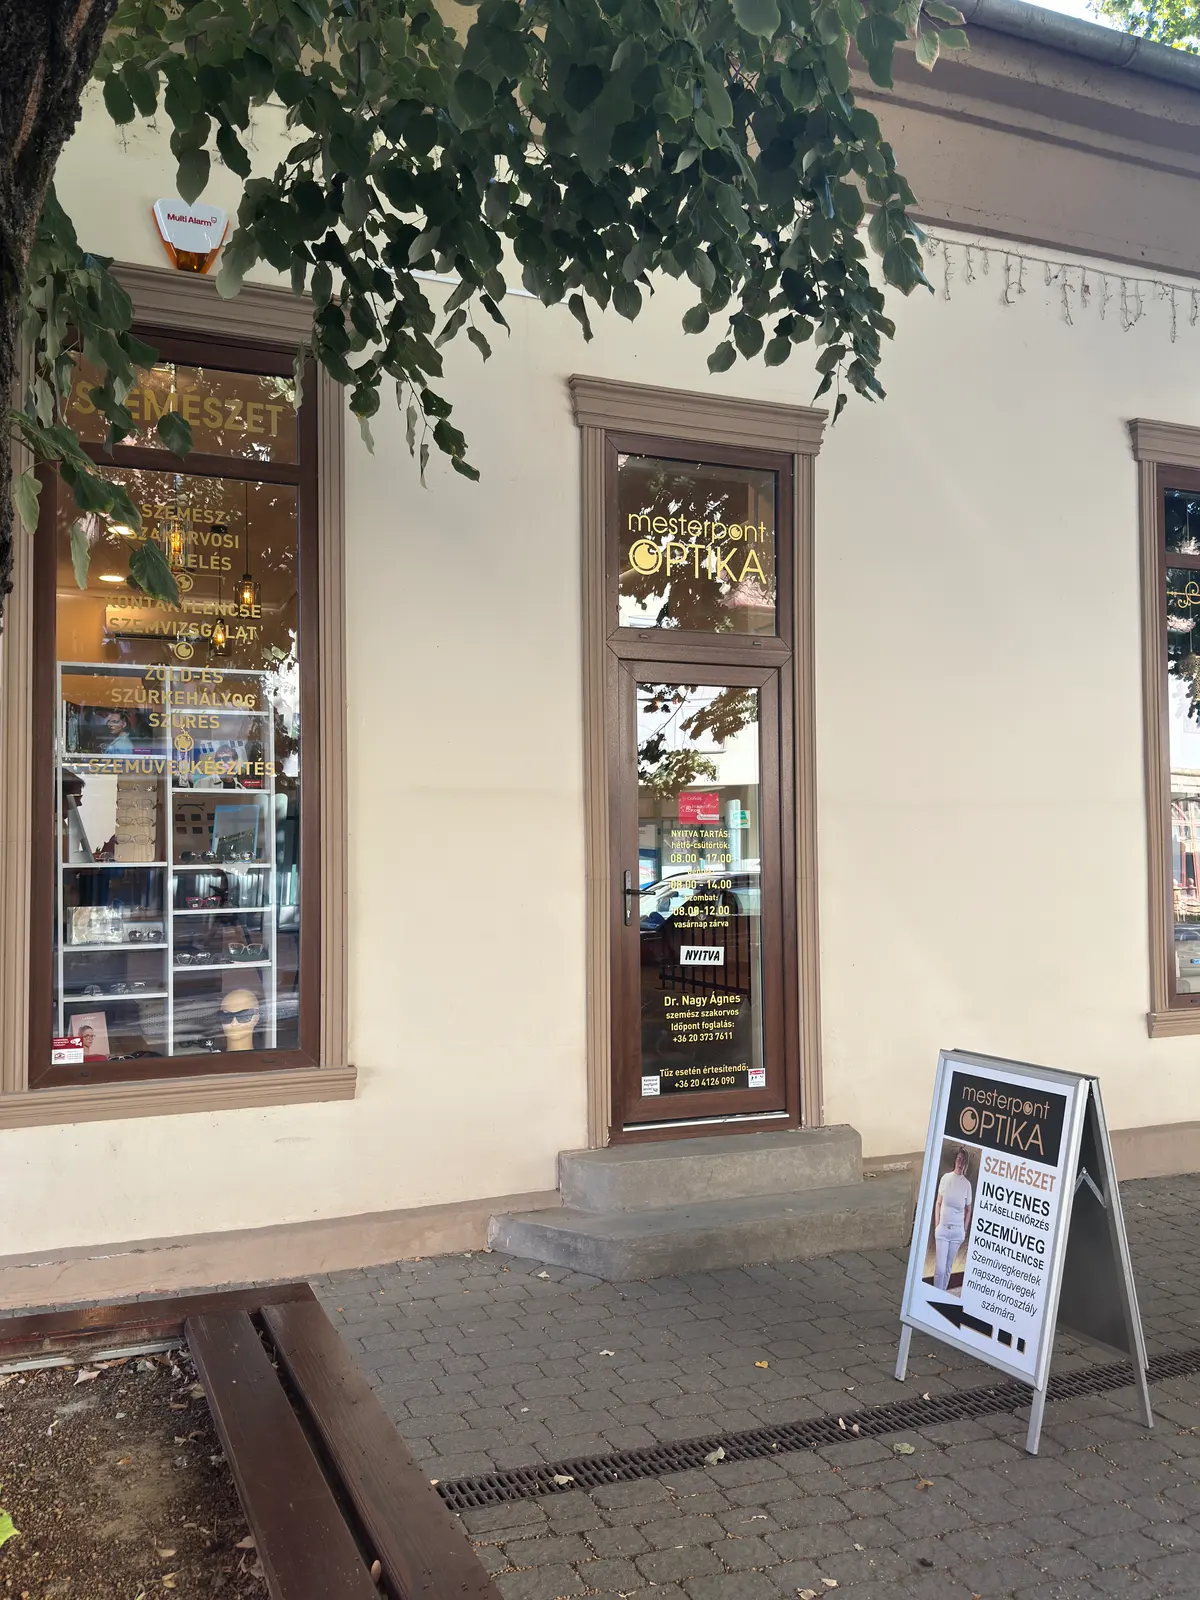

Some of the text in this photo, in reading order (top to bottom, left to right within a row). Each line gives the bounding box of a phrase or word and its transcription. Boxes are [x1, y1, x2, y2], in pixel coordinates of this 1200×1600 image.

[167, 213, 212, 227] Multi Alarm
[72, 381, 284, 437] SEMÉSZET
[142, 503, 226, 525] SZEMÉSZ
[628, 513, 767, 543] mesterpont
[628, 538, 767, 585] OPTIKA
[108, 617, 257, 641] SZEMVIZSGÁLAT
[144, 663, 224, 684] ZÖLD-ÉS
[110, 686, 256, 708] SZÜRKEHÁLYOG
[671, 828, 731, 838] NYITVA TARTÁS:
[670, 853, 697, 864] 08.00
[706, 853, 732, 864] 17.00
[706, 879, 732, 889] 14.00
[673, 919, 729, 929] vasárnap zárva
[685, 949, 720, 961] NYITVA
[664, 990, 741, 1007] Dr. Nagy Ágnes
[665, 1008, 740, 1019] szemész szakorvos
[671, 1019, 735, 1032] Időpont foglalás:
[672, 1031, 733, 1043] +36 20 373 7611
[659, 1068, 674, 1077] Tűz
[675, 1066, 701, 1076] esetén
[674, 1076, 735, 1088] +36 20 4126 090
[962, 1085, 1051, 1120] mesterpont
[959, 1106, 1044, 1156] OPTIKA
[983, 1156, 1057, 1193] SZEMÉSZET
[981, 1181, 1050, 1217] INGYENES
[979, 1200, 1050, 1232] LÁTÁSELLENŐRZÉS
[976, 1218, 1046, 1255] SZEMÜVEG
[973, 1235, 1045, 1270] KONTAKTLENCSE
[971, 1250, 1042, 1286] Szemüvegkeretek
[972, 1267, 1037, 1300] napszemüvegek
[966, 1279, 1038, 1318] minden korosztály
[980, 1300, 1017, 1323] számára.
